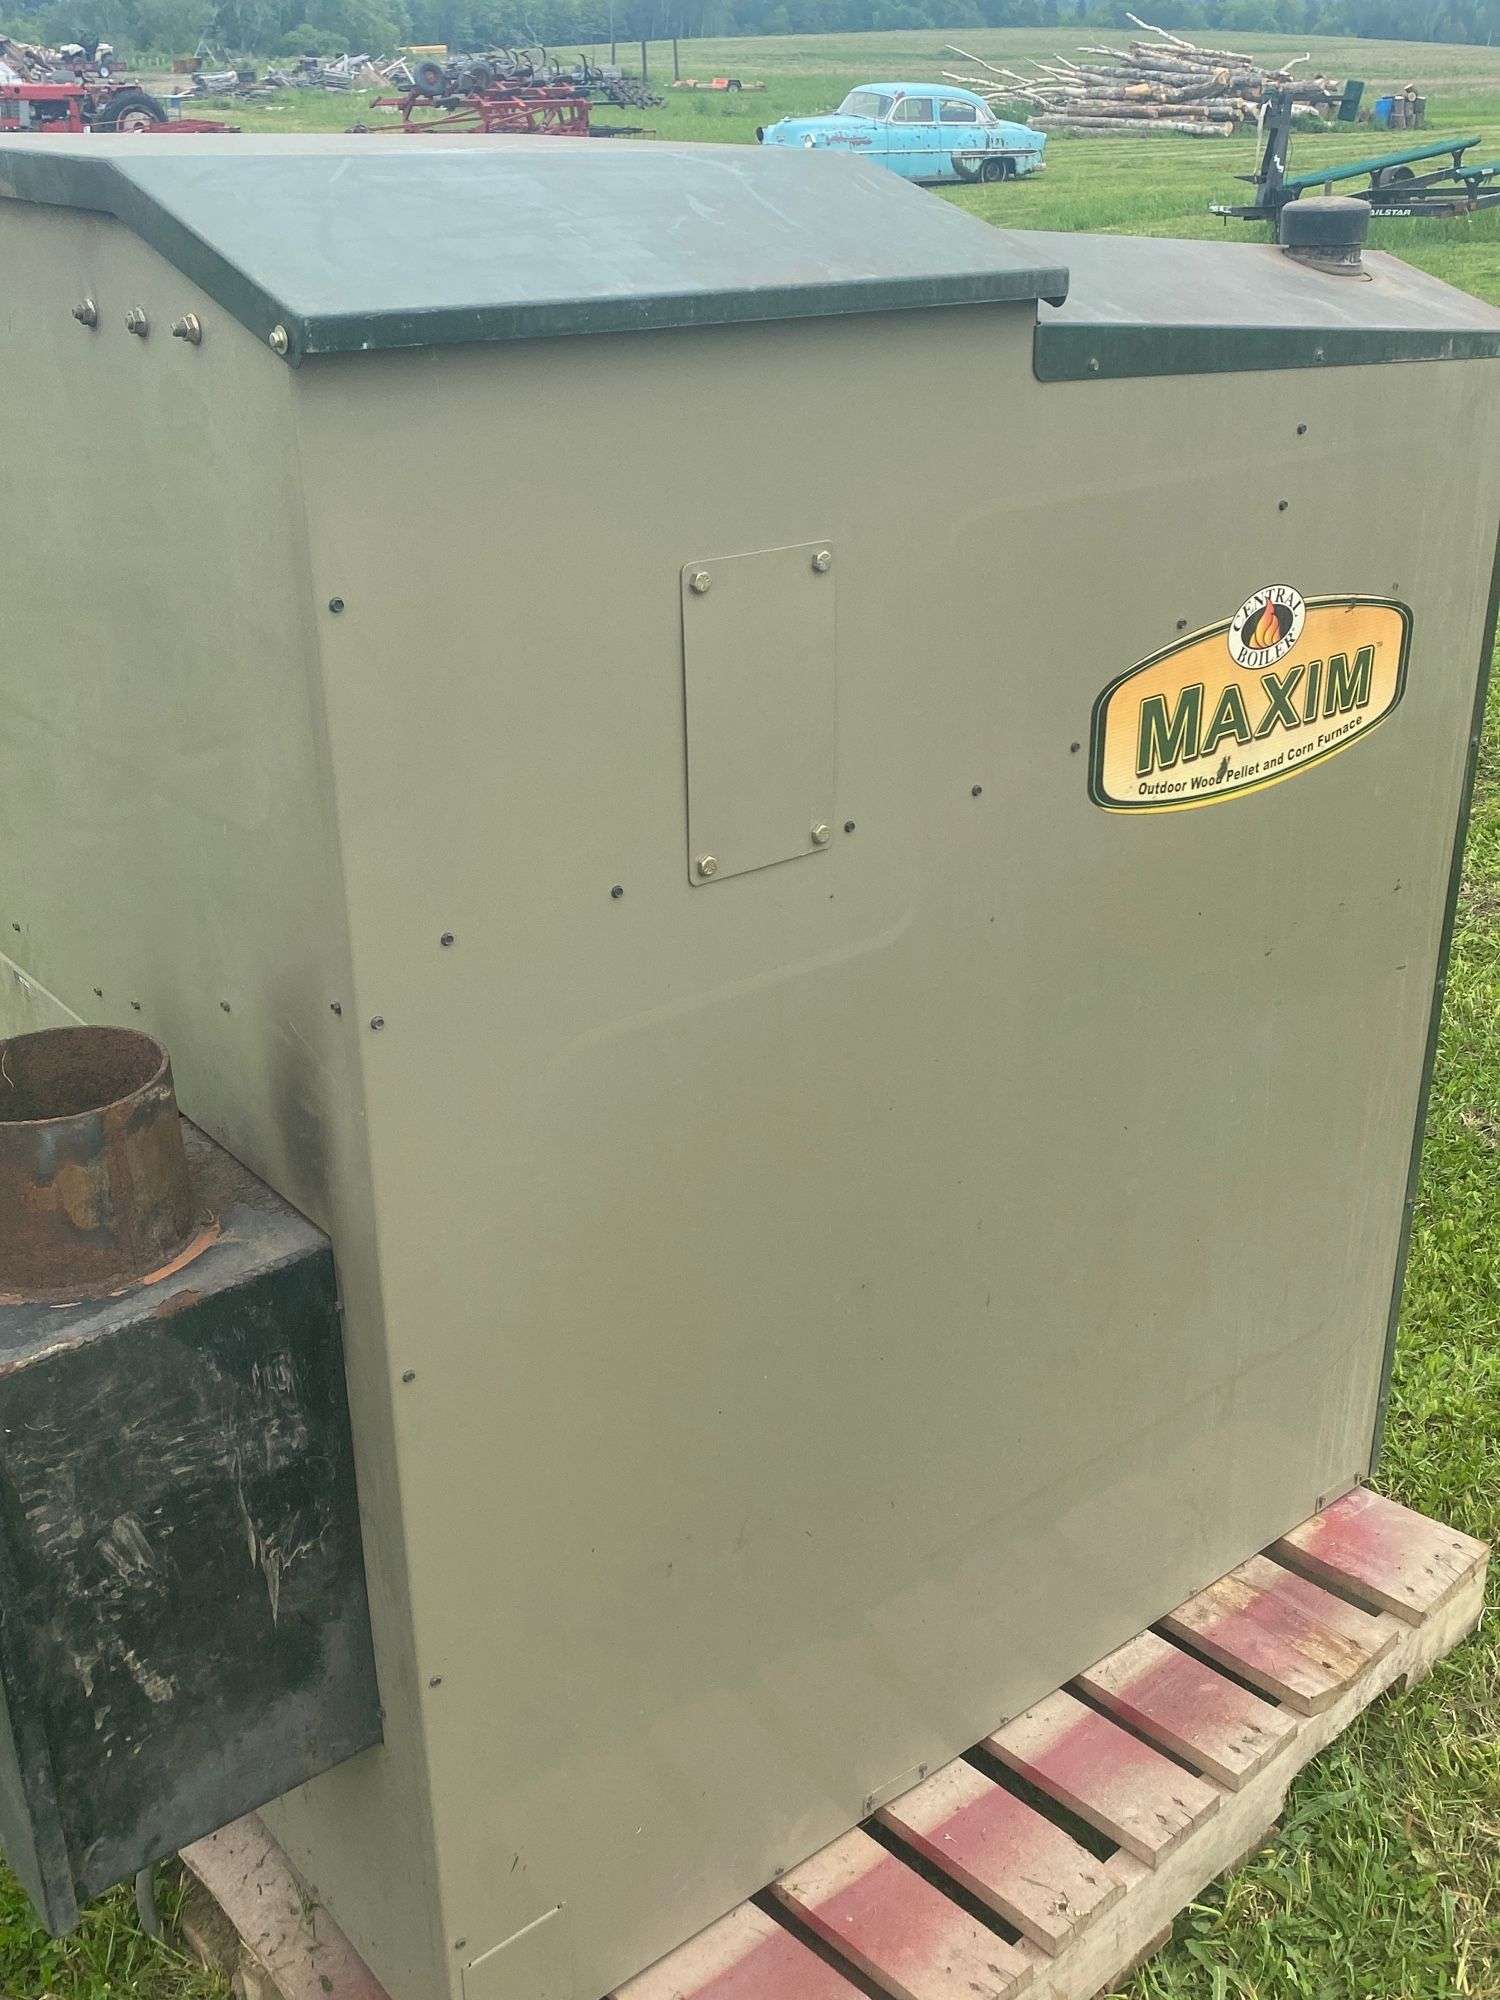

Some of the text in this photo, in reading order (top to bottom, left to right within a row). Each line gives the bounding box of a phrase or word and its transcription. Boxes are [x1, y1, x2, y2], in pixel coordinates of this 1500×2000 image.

[1233, 587, 1301, 632] CENTRAL
[1237, 632, 1296, 667] BOILER
[1135, 644, 1376, 777] MAXIM
[1138, 781, 1187, 795] Outdoor
[1226, 762, 1260, 782] Pellet
[1263, 752, 1284, 770] and
[1287, 742, 1314, 761] Corn
[1317, 716, 1362, 747] Furnace
